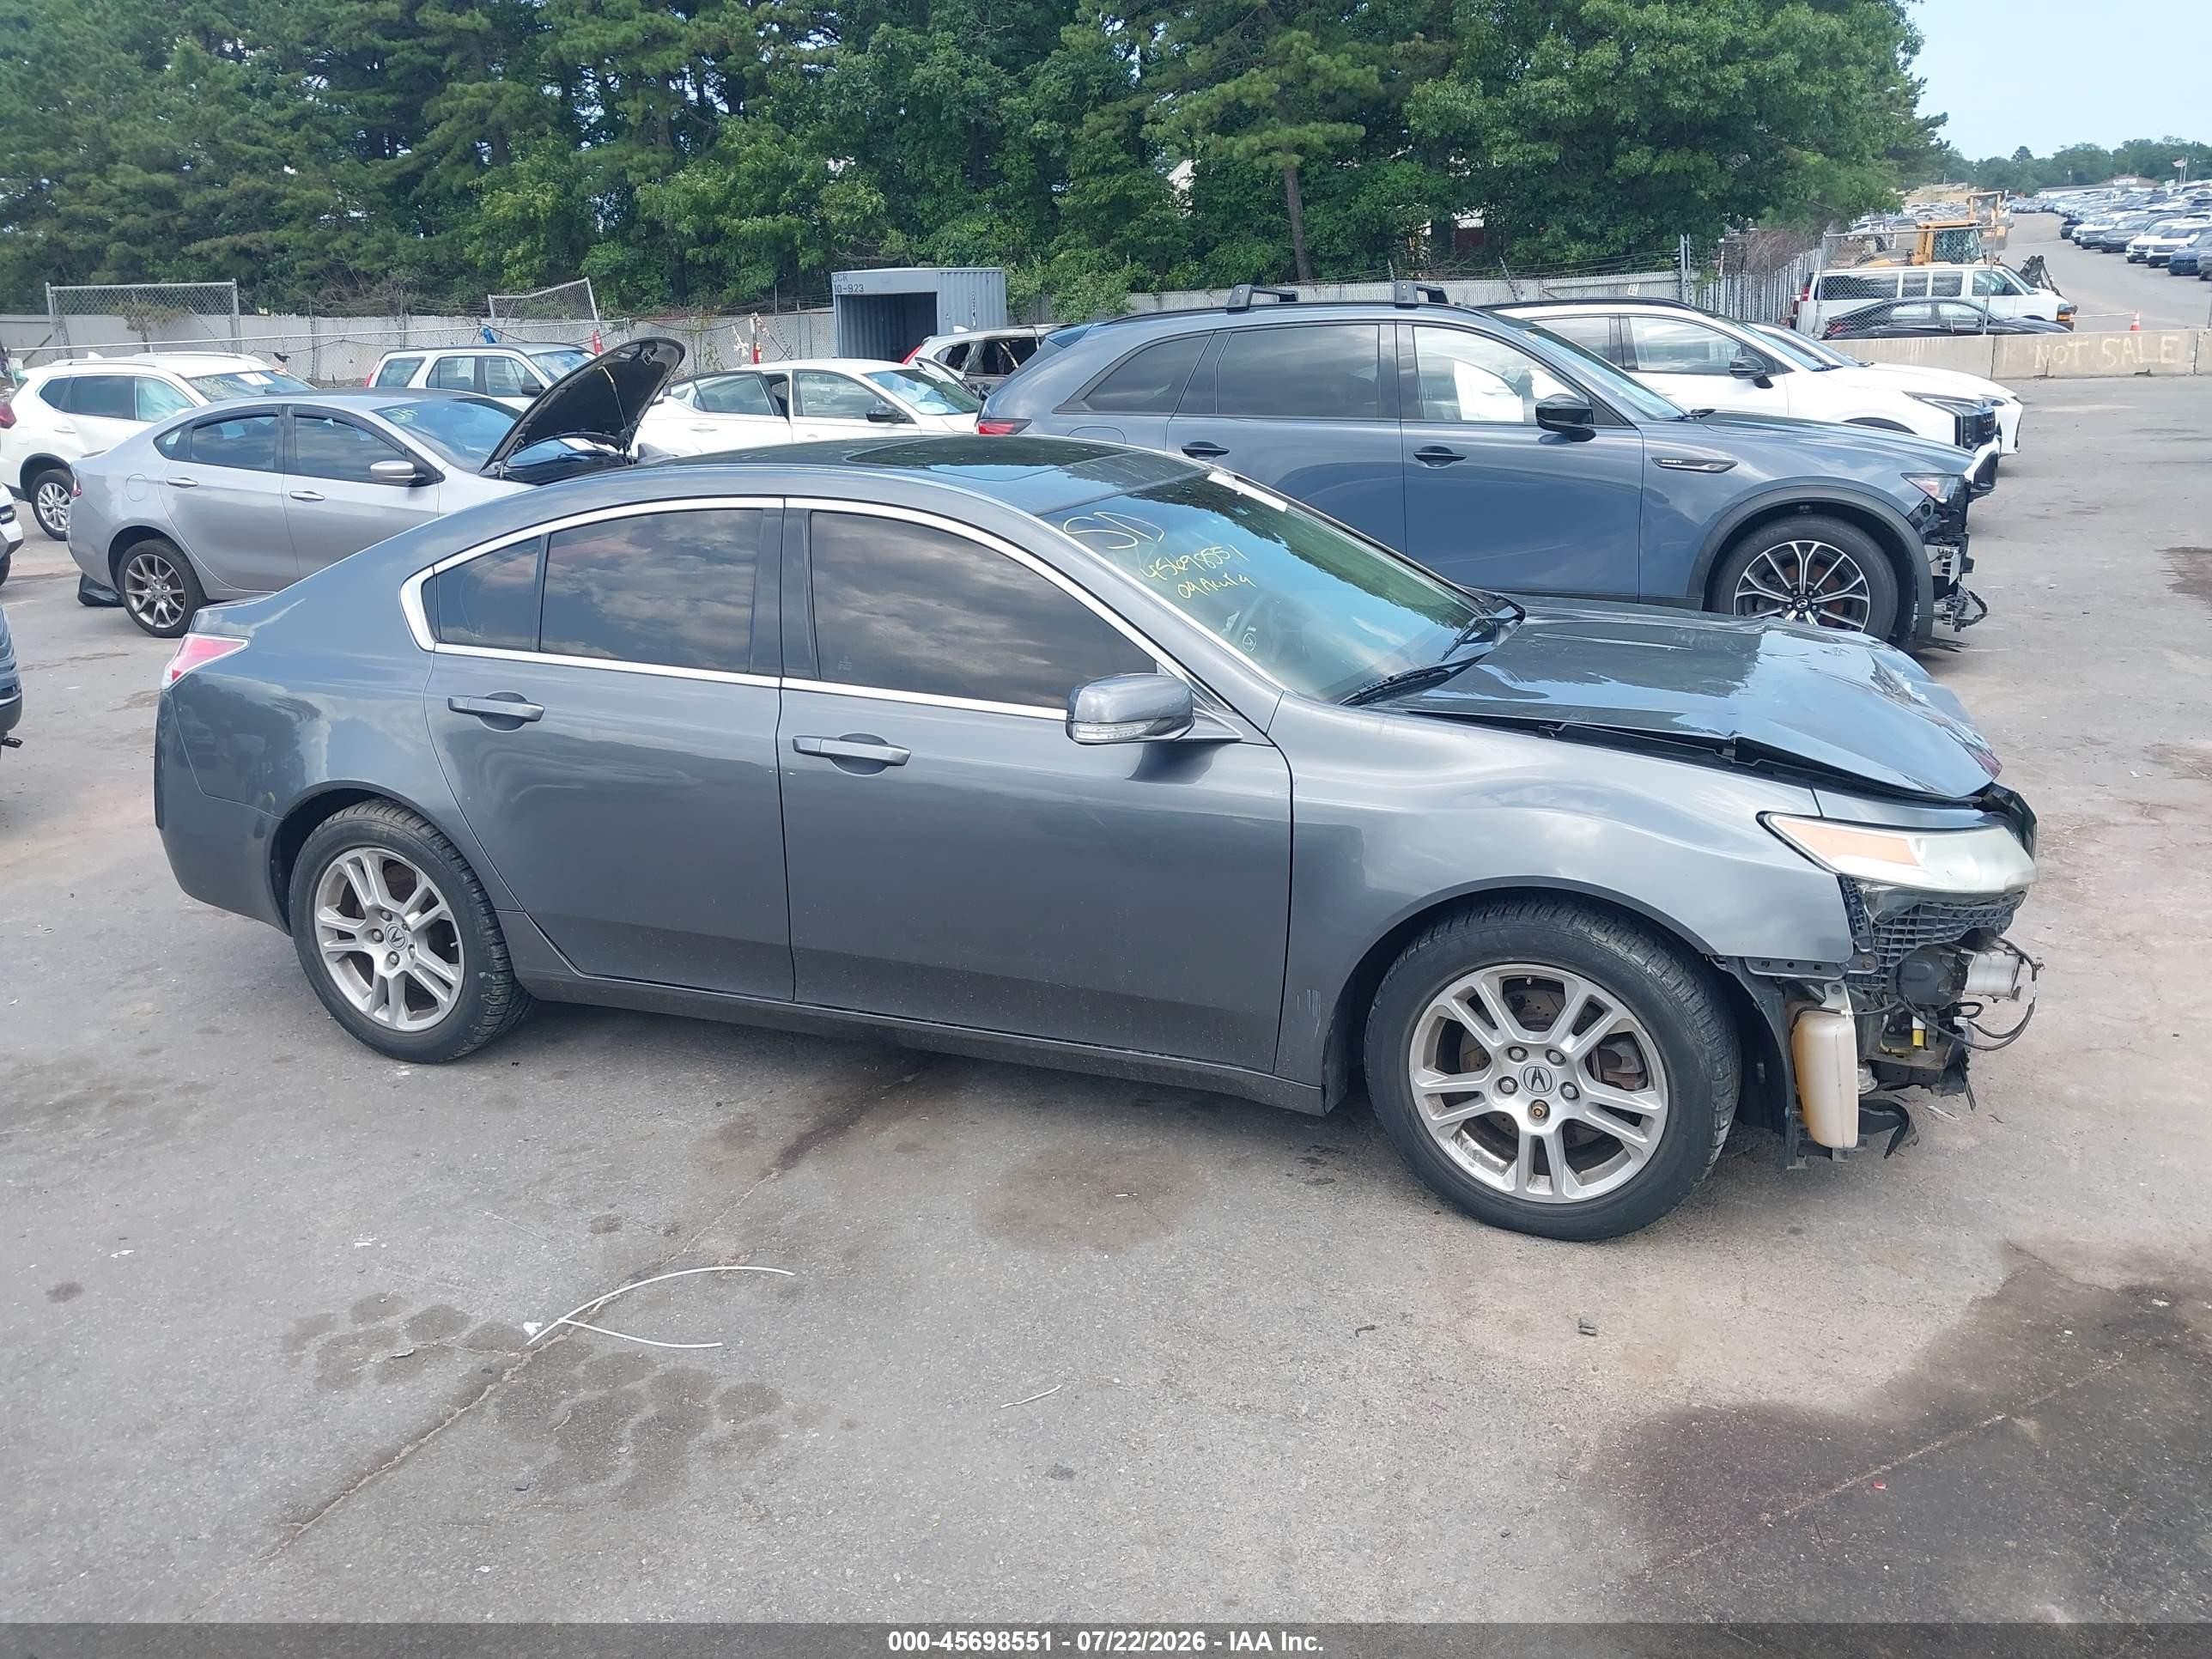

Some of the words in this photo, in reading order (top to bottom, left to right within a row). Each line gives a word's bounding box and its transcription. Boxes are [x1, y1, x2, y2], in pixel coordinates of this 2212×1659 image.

[833, 283, 865, 294] 10-923
[2033, 340, 2089, 370] NOT
[2099, 335, 2181, 368] SALE
[1063, 512, 1165, 550] SD
[1140, 544, 1250, 580] 45698551
